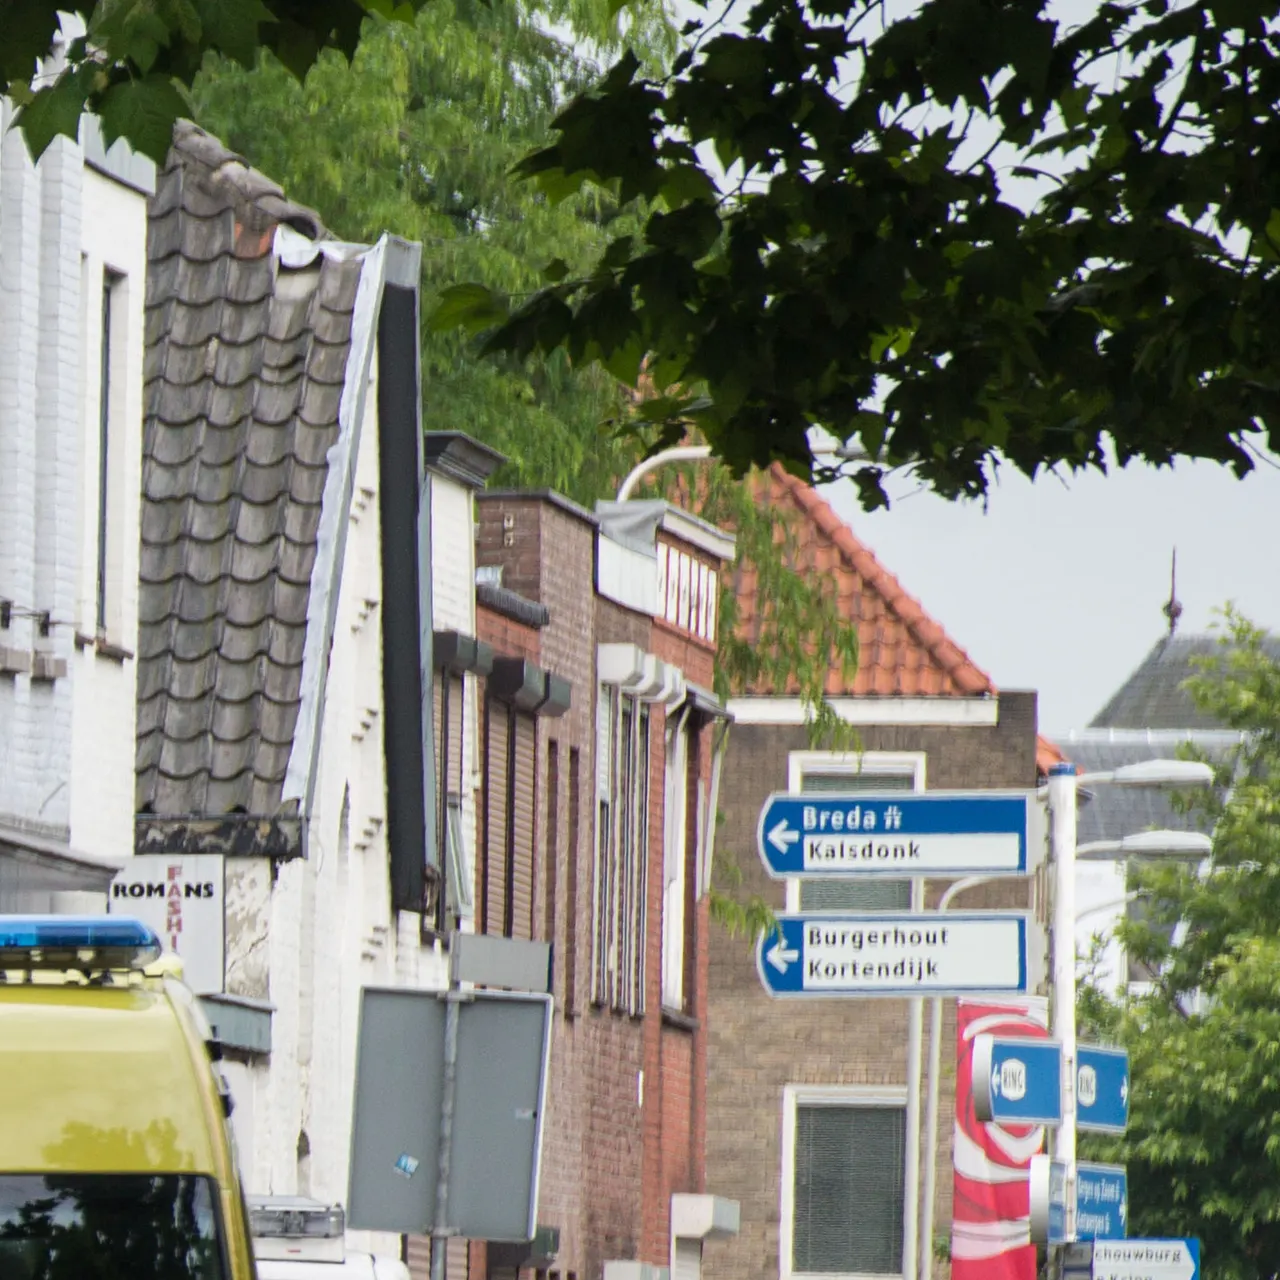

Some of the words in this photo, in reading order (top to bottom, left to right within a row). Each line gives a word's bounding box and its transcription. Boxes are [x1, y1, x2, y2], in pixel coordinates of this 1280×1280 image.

[803, 806, 876, 830] Breda
[809, 841, 920, 860] Kalsdonk
[113, 883, 214, 898] ROMANS
[809, 927, 948, 949] Burgerhout
[809, 961, 939, 983] Kortendijk
[1003, 1067, 1023, 1092] RING
